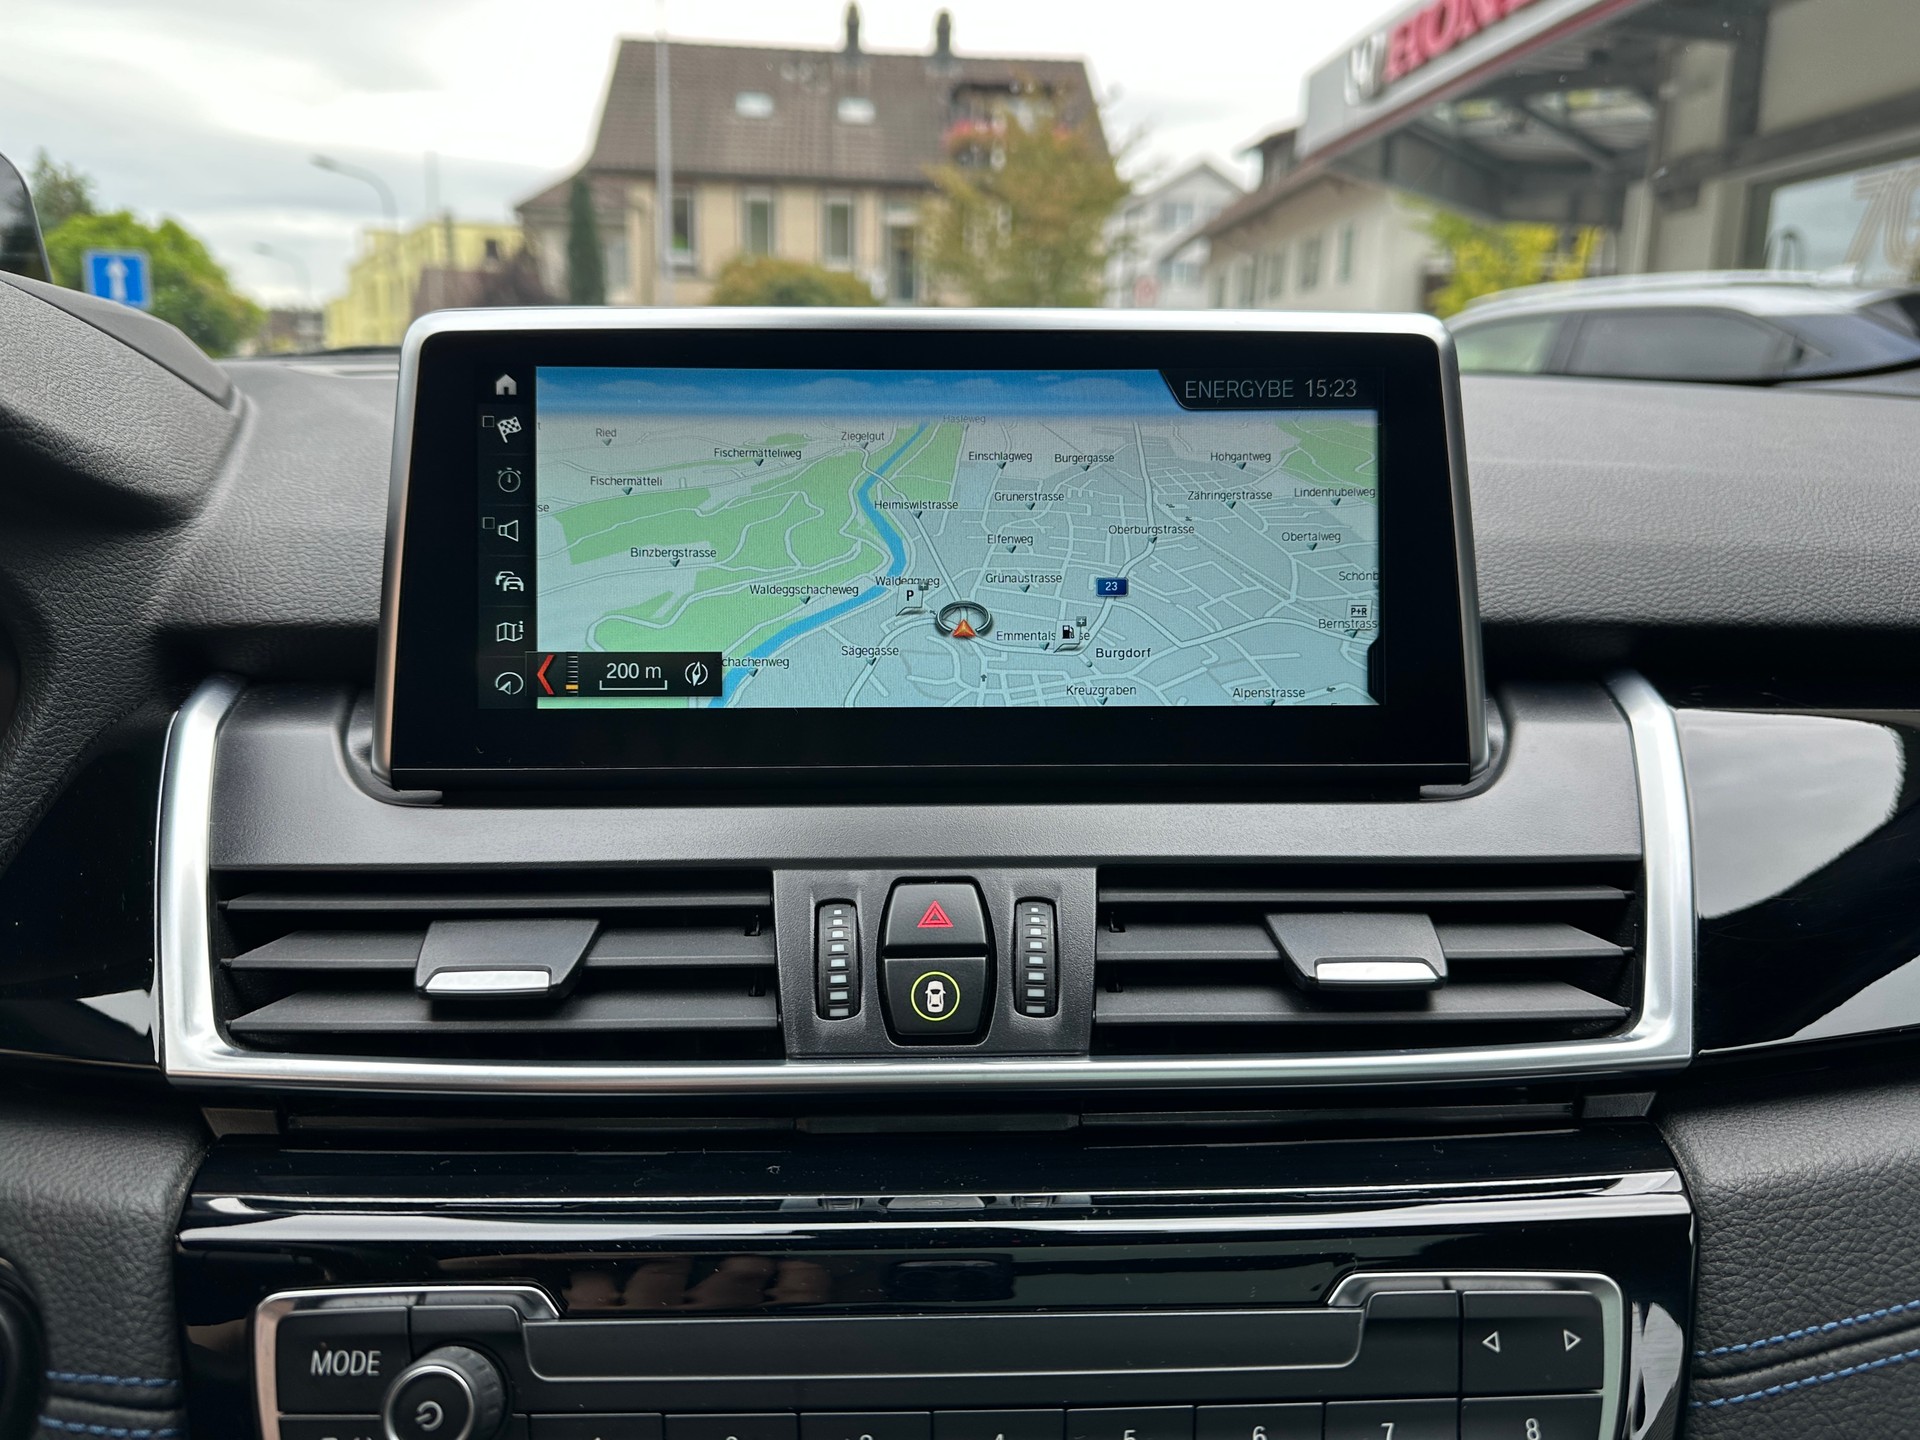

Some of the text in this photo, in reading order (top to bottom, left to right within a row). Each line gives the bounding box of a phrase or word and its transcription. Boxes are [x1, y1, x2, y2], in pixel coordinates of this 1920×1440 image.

[1185, 379, 1357, 398] ENERGYBE 15:23
[595, 428, 617, 438] Ried
[841, 432, 885, 443] Ziegelgut
[714, 448, 802, 459] Fischermätteliweg
[968, 451, 1033, 462] Einschlagweg
[1054, 453, 1115, 464] Burgergasse
[1210, 452, 1271, 463] Hohgantweg
[590, 476, 663, 487] Fischermätteli
[994, 492, 1065, 502] Grunerstrasse
[1187, 490, 1273, 502] Zähringerstrasse
[1294, 488, 1376, 499] Lindenhubelweg
[874, 500, 959, 510] Heimiswilstrasse
[1108, 524, 1195, 536] Oberburgstrasse
[987, 534, 1034, 546] Elfenweg
[1281, 532, 1341, 543] Obertalweg
[630, 547, 717, 559] Binzbergstrasse
[985, 573, 1063, 584] Grünaustrasse
[750, 585, 859, 597] Waldeggschacheweg
[1105, 581, 1118, 592] 23
[906, 590, 914, 601] P
[1350, 607, 1367, 616] P+R
[841, 646, 899, 657] Sägegasse
[1095, 648, 1151, 660] Burgdorf
[721, 657, 790, 669] chachenweg
[606, 663, 662, 680] 200 m
[1066, 685, 1137, 697] Kreuzgraben
[1232, 688, 1306, 700] Alpenstrasse
[310, 1350, 381, 1376] MODE
[1381, 1422, 1395, 1440] 7
[1525, 1417, 1541, 1440] 8
